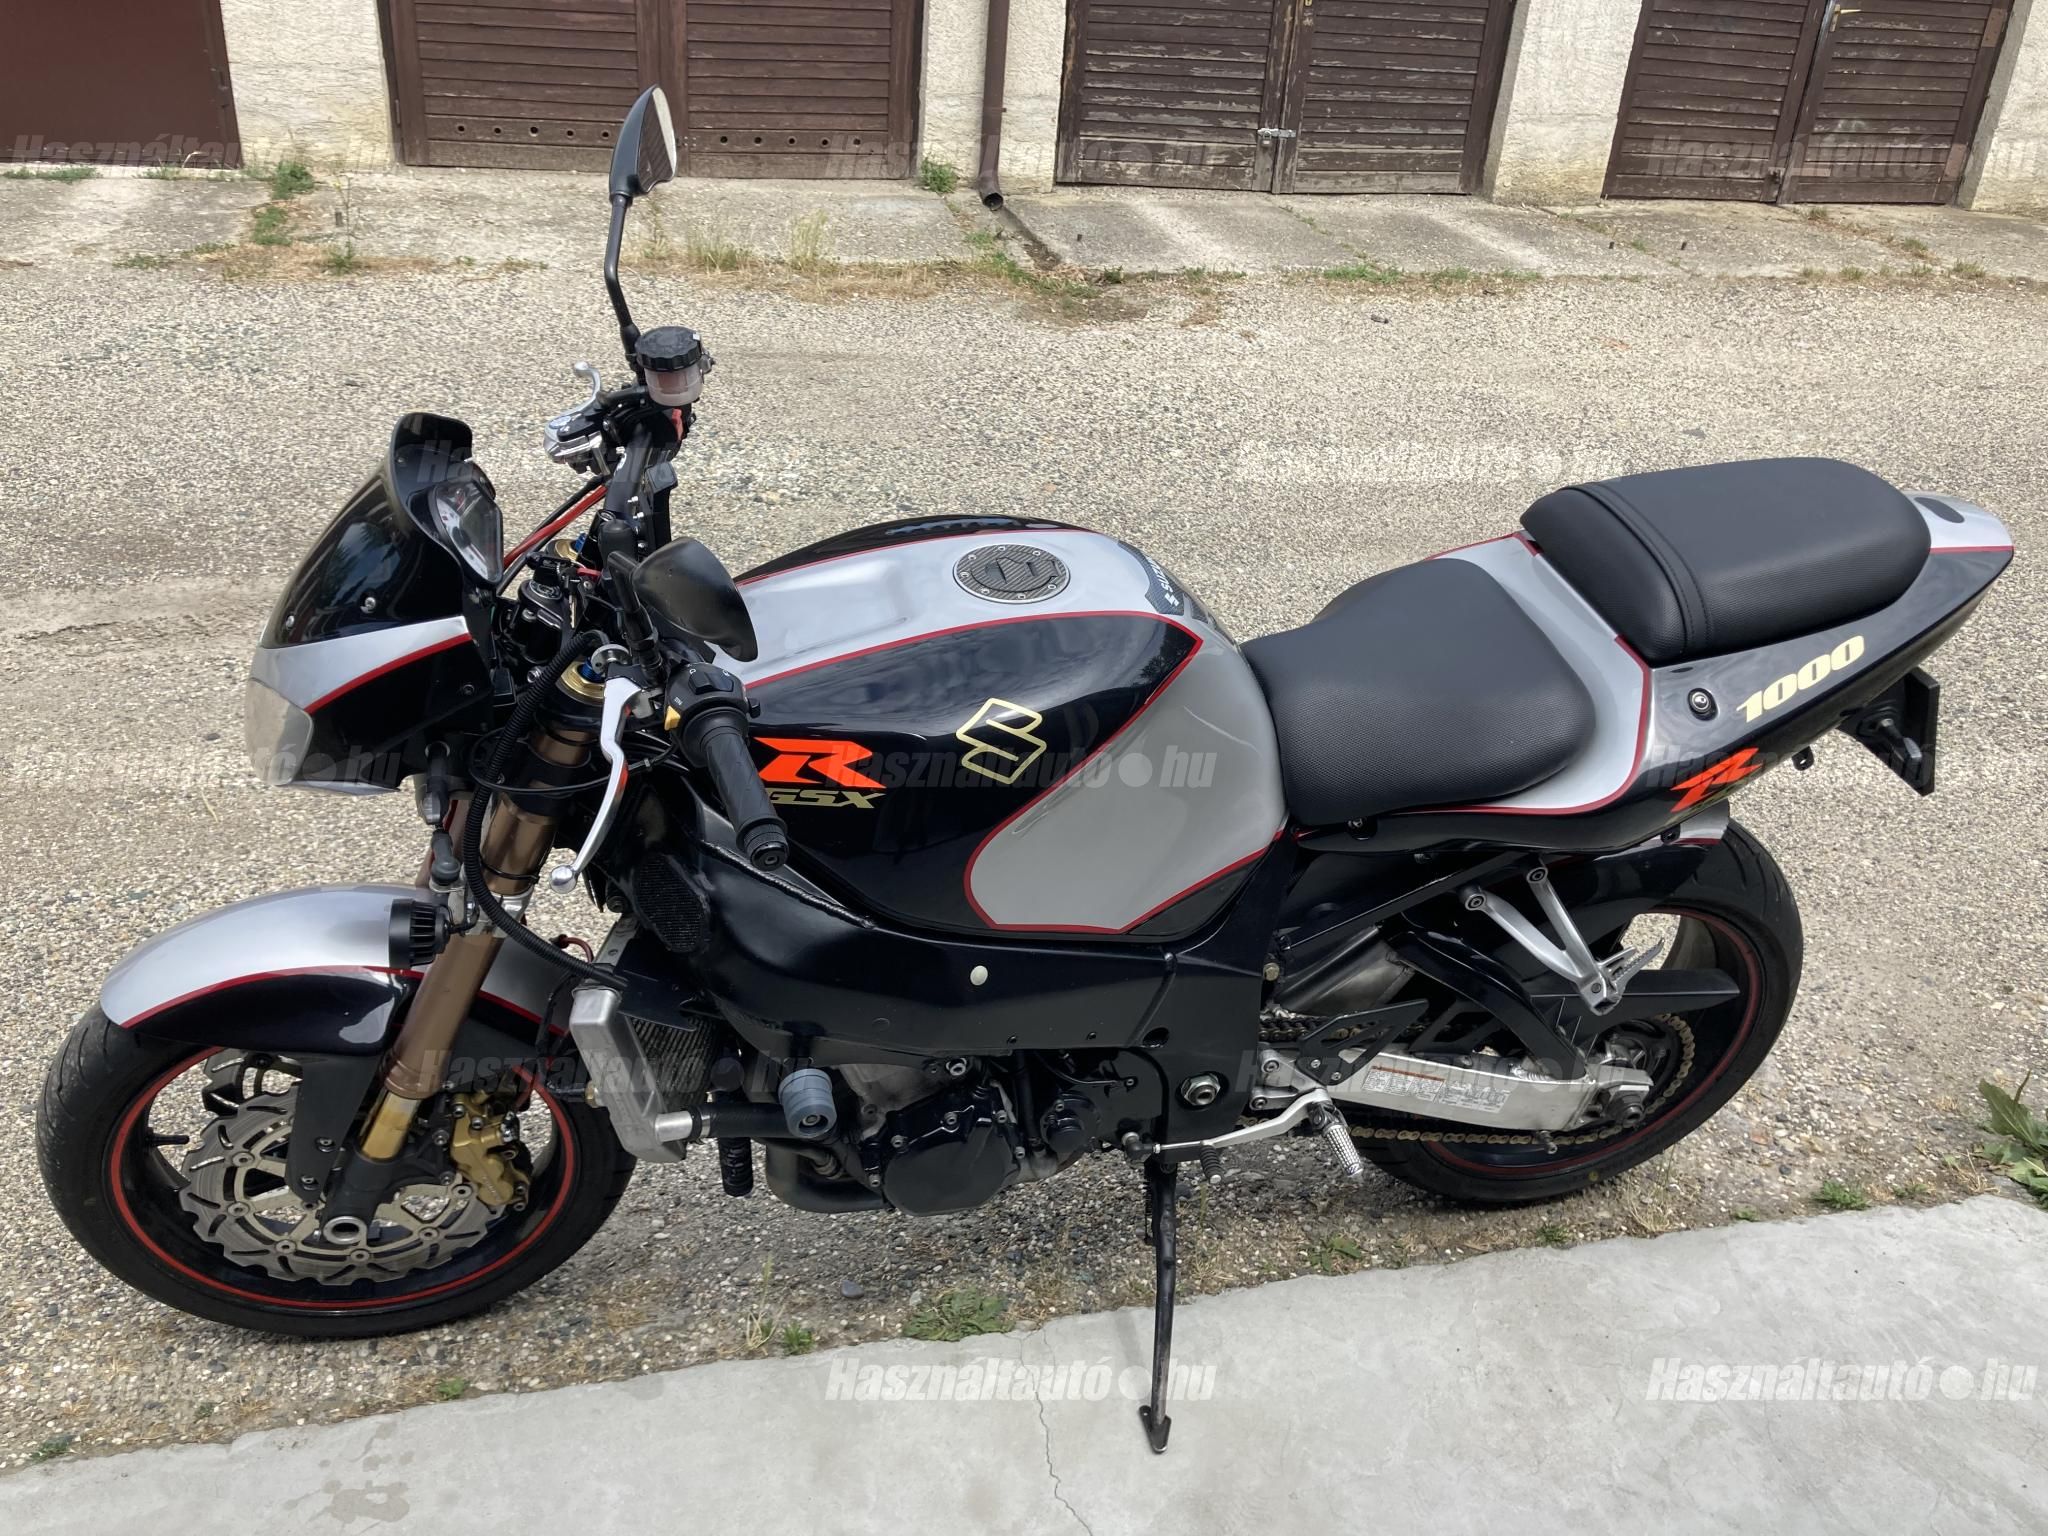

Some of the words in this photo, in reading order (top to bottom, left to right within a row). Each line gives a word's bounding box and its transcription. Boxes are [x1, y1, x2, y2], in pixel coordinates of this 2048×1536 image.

[1736, 635, 1865, 723] 1000
[753, 736, 887, 788] R
[765, 787, 887, 809] GSX
